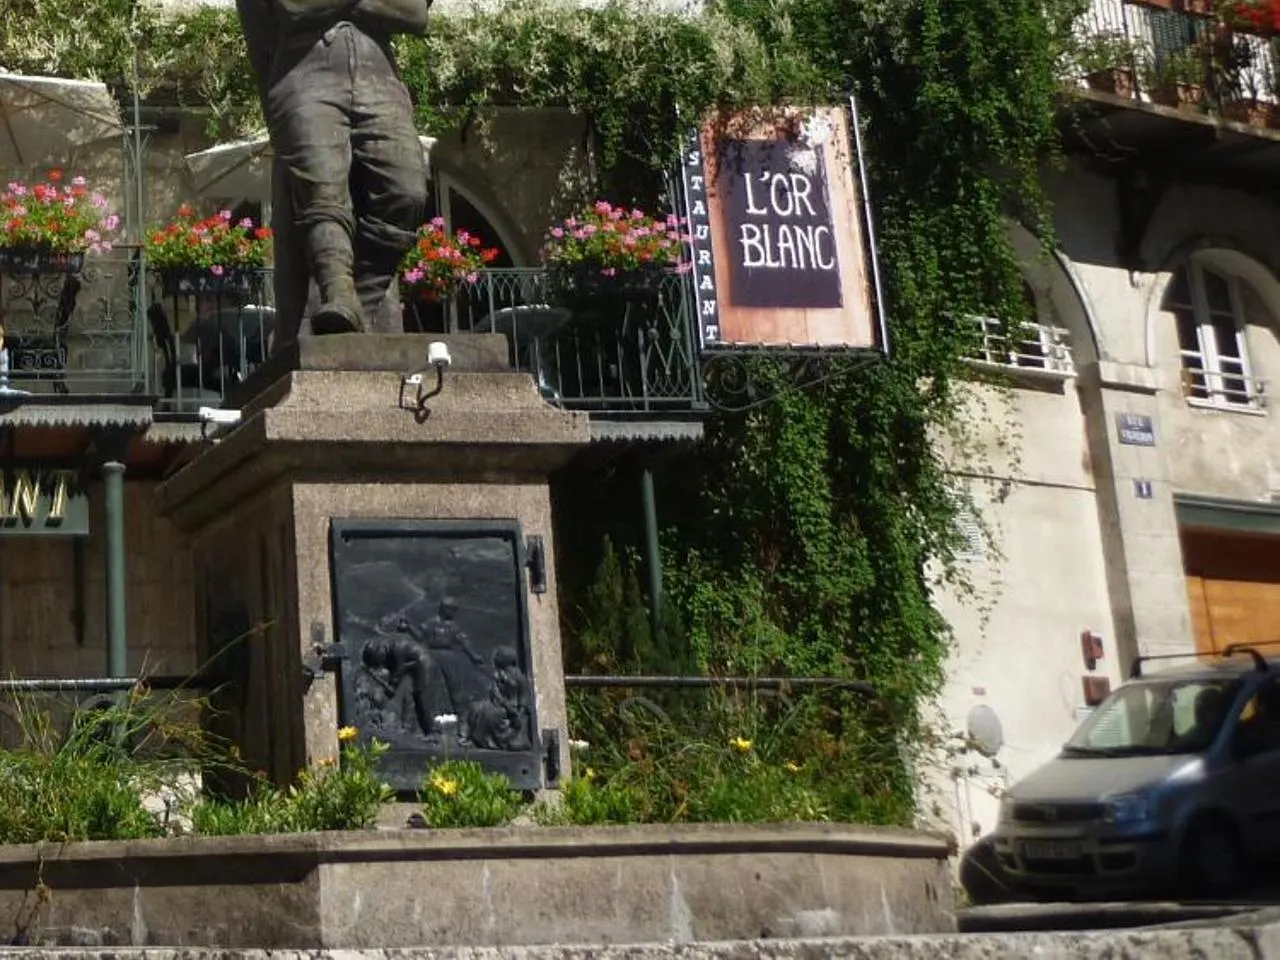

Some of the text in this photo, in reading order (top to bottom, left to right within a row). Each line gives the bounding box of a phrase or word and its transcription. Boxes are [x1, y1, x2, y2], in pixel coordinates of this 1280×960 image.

[743, 172, 817, 217] L'OR
[688, 128, 719, 340] STAURANT
[740, 223, 835, 270] BLANC
